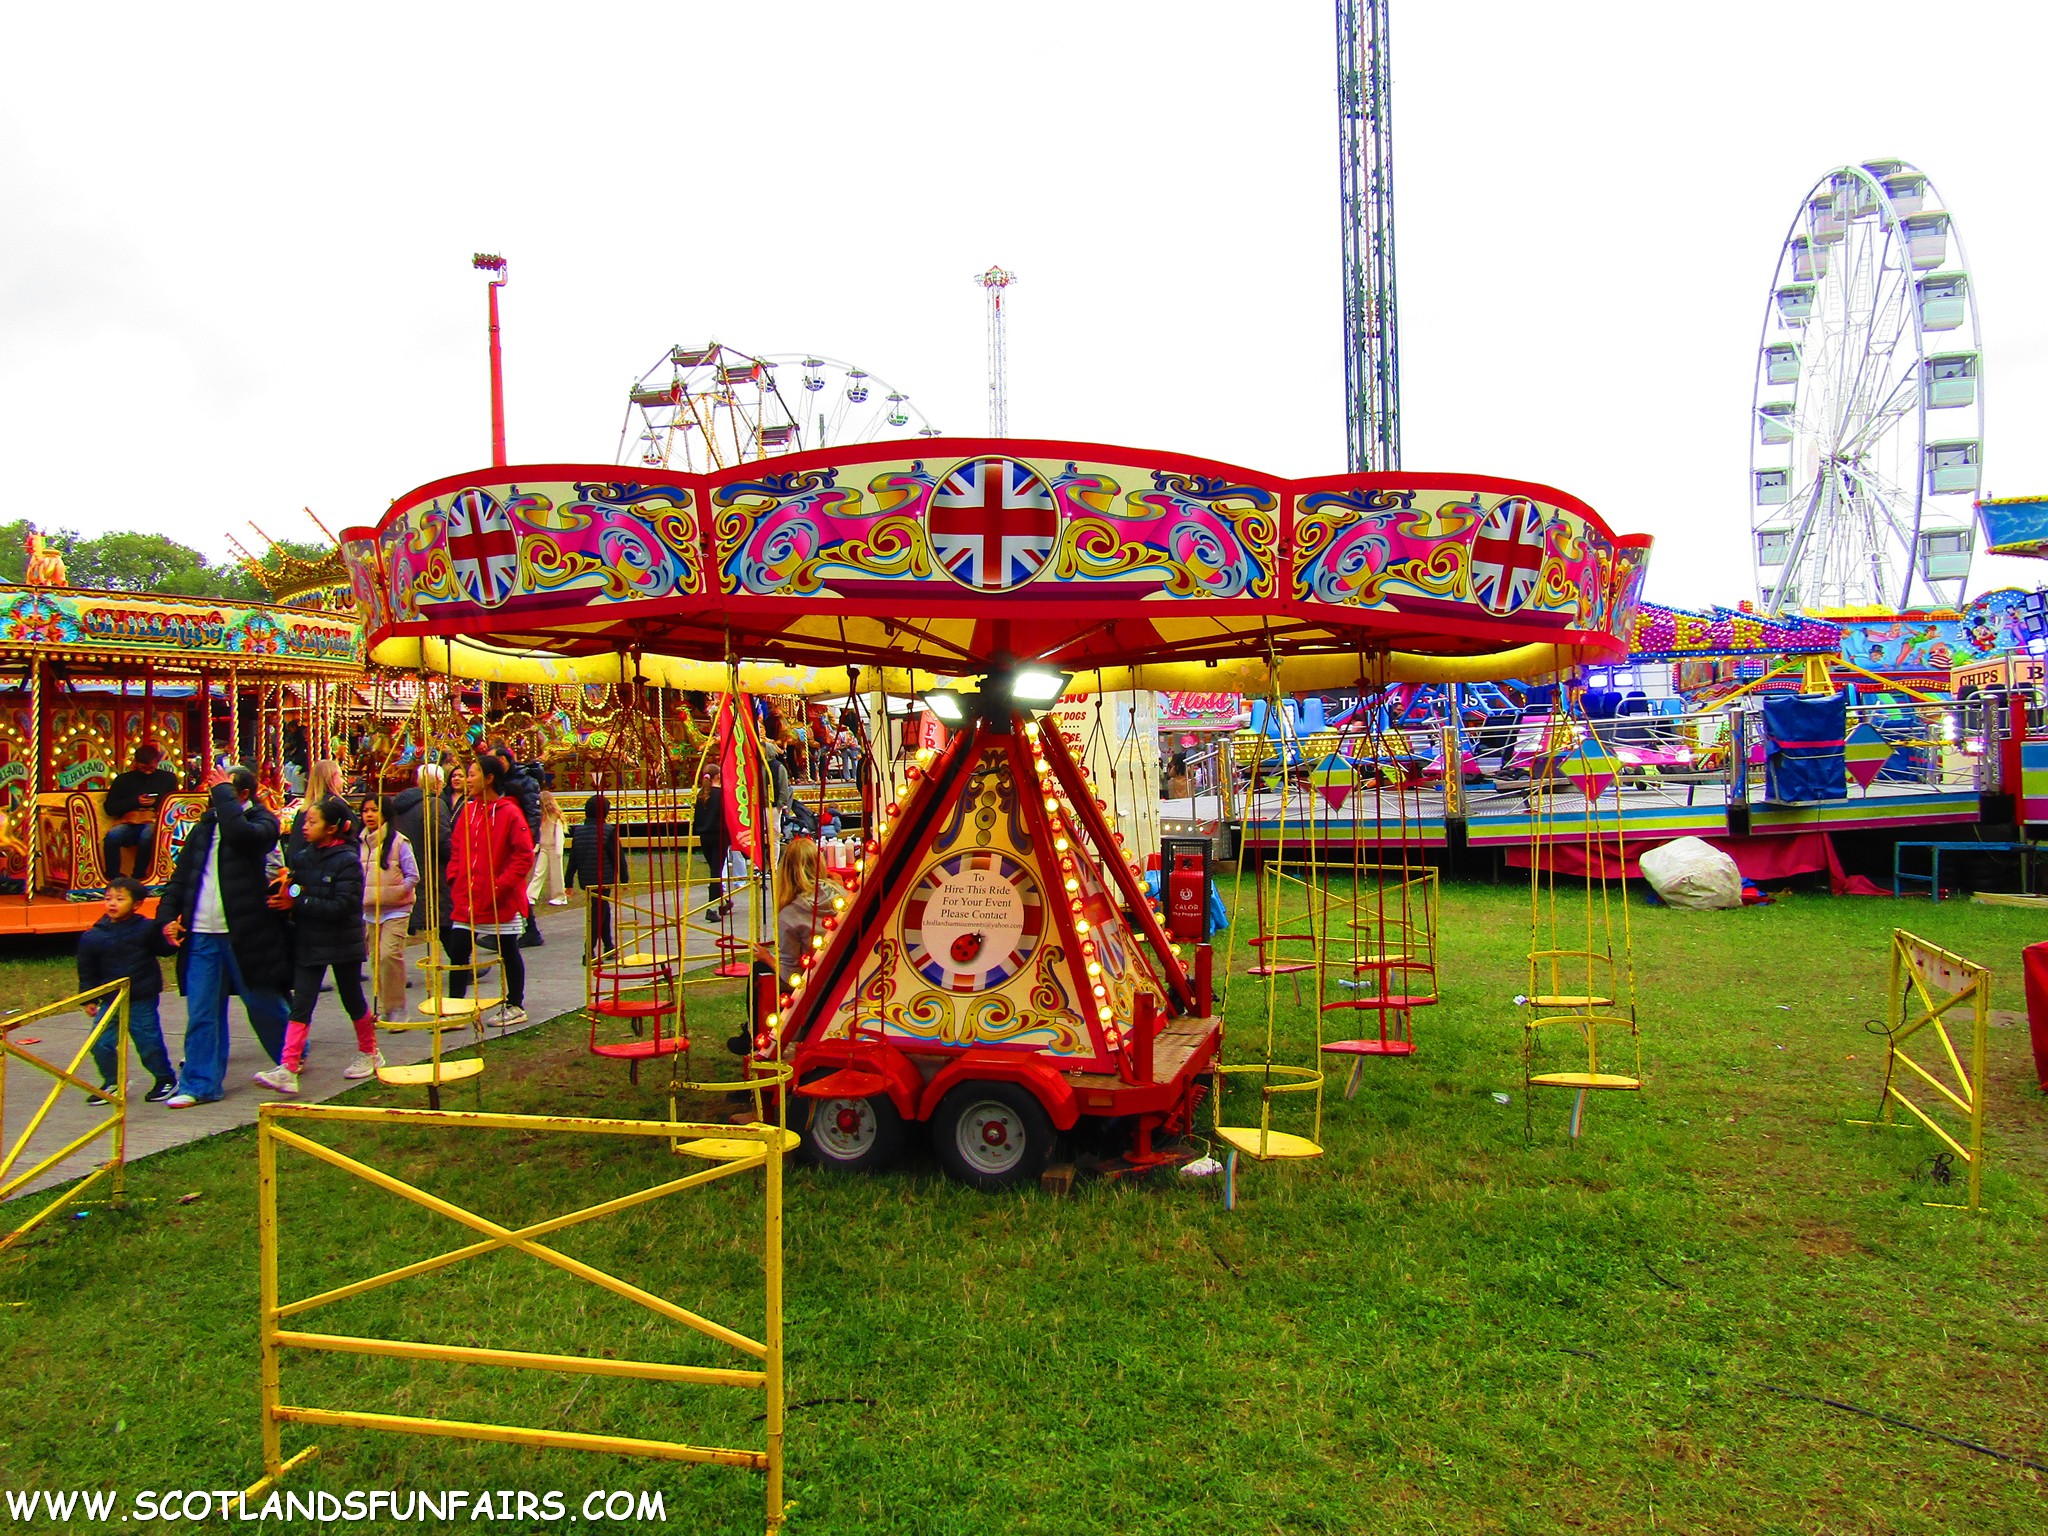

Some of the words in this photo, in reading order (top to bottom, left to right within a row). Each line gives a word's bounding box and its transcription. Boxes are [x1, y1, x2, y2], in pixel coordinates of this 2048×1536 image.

[1960, 669, 1998, 687] CHIPS
[1064, 711, 1087, 720] DOGS
[973, 873, 985, 882] To
[944, 885, 964, 894] Hire
[967, 885, 986, 895] This
[989, 885, 1011, 895] Ride
[942, 897, 959, 906] For
[961, 897, 983, 907] Your
[985, 898, 1012, 908] Event
[941, 909, 970, 918] Please
[972, 909, 1007, 920] Contact
